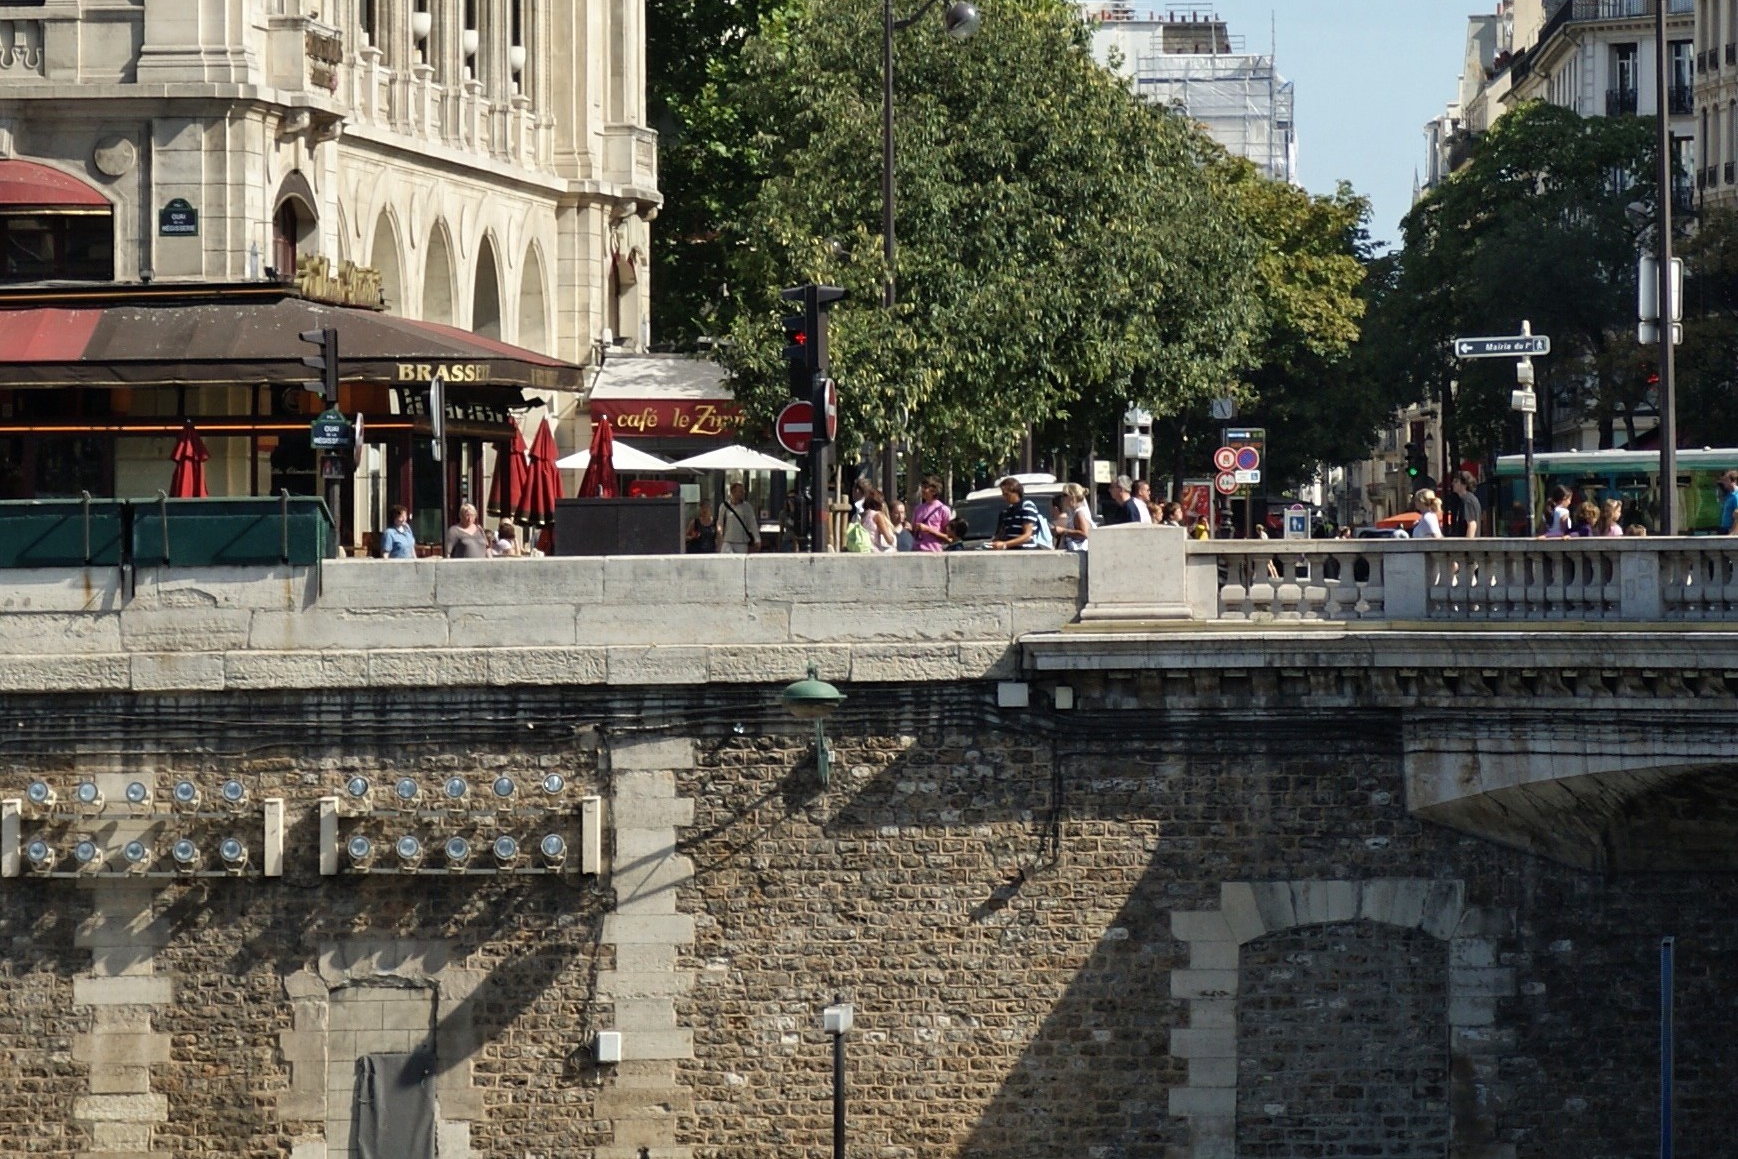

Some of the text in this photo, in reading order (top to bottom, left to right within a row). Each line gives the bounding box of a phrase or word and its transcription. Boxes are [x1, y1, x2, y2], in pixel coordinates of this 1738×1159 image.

[1485, 342, 1511, 351] Mairie
[1514, 342, 1523, 350] du
[617, 408, 657, 431] café
[672, 408, 690, 428] le
